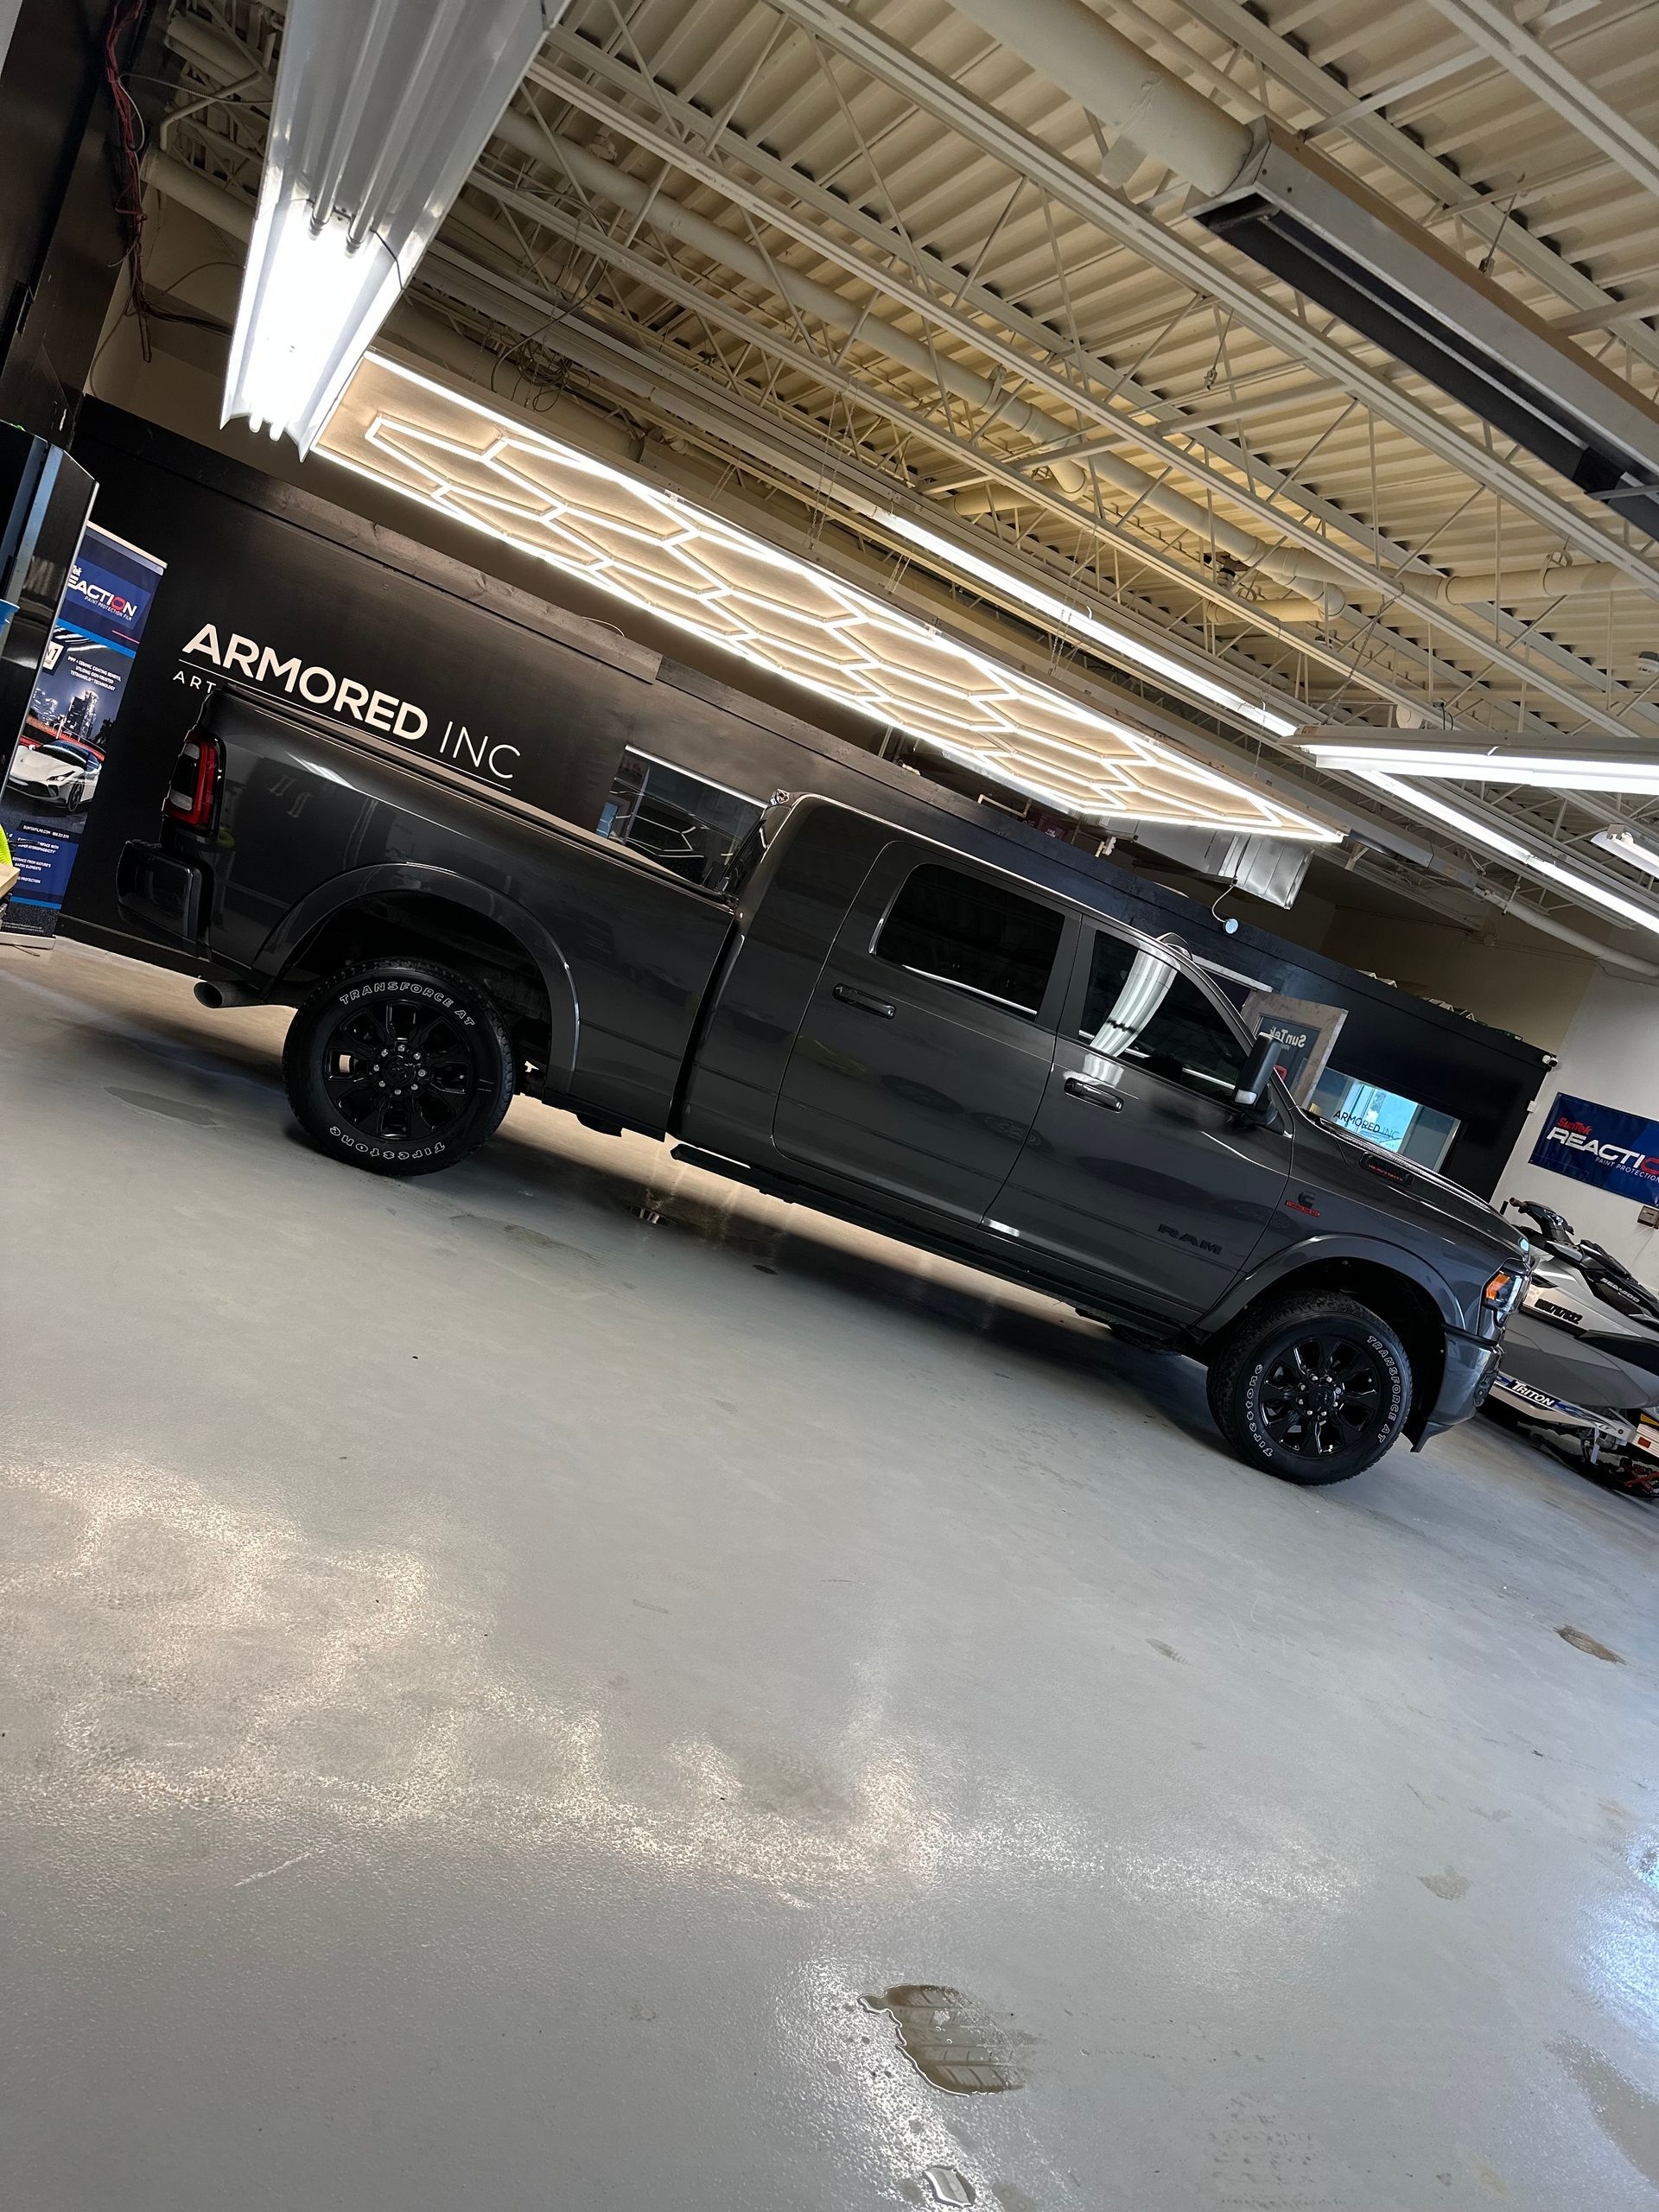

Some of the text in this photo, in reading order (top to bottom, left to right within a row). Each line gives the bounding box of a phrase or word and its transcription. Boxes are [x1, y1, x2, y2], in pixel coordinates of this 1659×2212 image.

[72, 564, 82, 576] Tek
[67, 575, 137, 617] EACTION
[173, 671, 217, 694] ART
[182, 623, 520, 779] ARMORED INC
[340, 981, 475, 1027] TRANSFORCE AT
[1333, 1110, 1381, 1134] ARMORED
[1557, 1117, 1592, 1135] SunTek
[1547, 1127, 1659, 1175] REACTIO
[1595, 1157, 1616, 1167] PAINT
[1158, 1224, 1223, 1255] RAM
[1367, 1335, 1402, 1444] TRANSFORCE AT
[1511, 1381, 1555, 1407] TRITON
